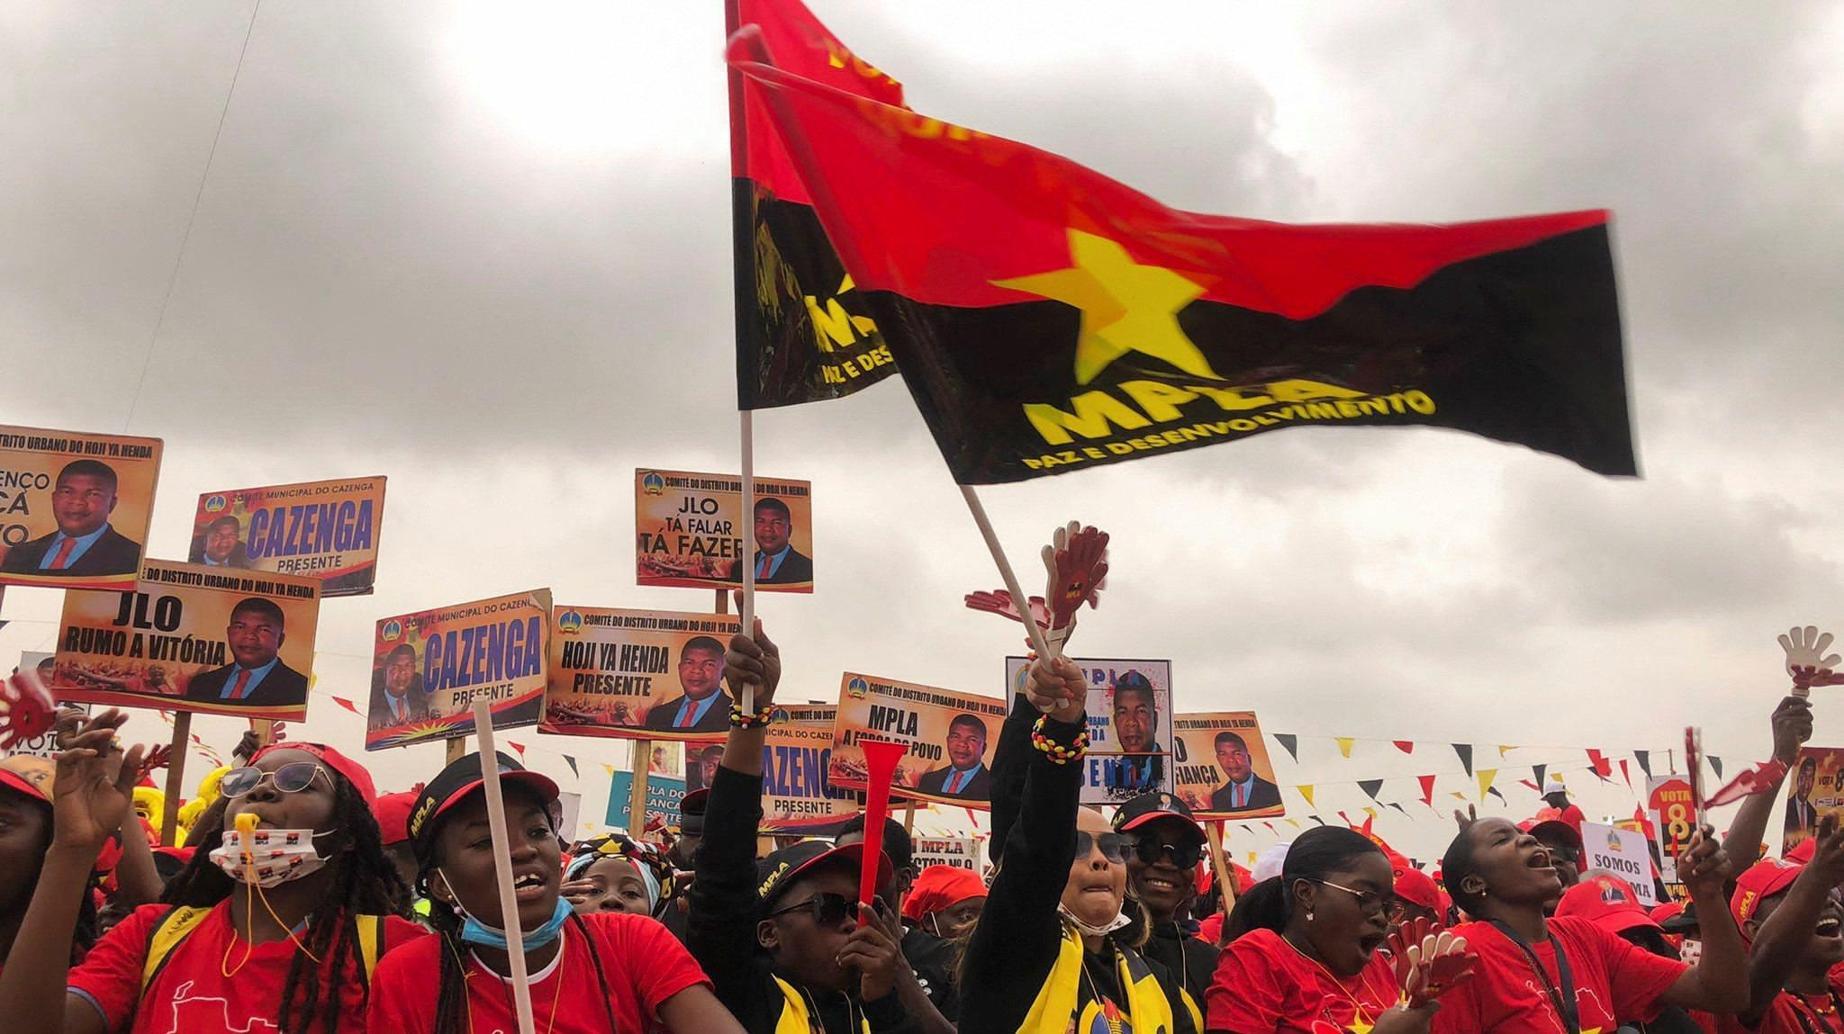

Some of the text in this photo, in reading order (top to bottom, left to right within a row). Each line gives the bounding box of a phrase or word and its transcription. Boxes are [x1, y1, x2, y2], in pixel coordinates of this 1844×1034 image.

[843, 360, 860, 378] E
[1022, 379, 1372, 446] MPLA
[1022, 389, 1437, 470] PAZ E DESENVOLVIMENTO
[27, 436, 69, 452] URBANO
[69, 440, 83, 453] DO
[84, 441, 107, 455] HOJI
[108, 444, 120, 457] YA
[121, 446, 153, 459] HENDA
[266, 488, 313, 499] MUNICIPAL
[315, 486, 330, 495] DO
[332, 483, 374, 493] CAZENGA
[678, 496, 719, 515] JLO
[246, 499, 373, 561] CAZENGA
[665, 514, 733, 536] TÁ FALAR
[640, 527, 744, 559] TÁ FAZER
[277, 555, 342, 572] PRESENTE
[147, 567, 160, 581] DO
[161, 569, 203, 586] DISTRITO
[203, 574, 241, 590] URBANO
[240, 579, 254, 592] DO
[254, 580, 275, 594] HOJI
[275, 583, 286, 596] YA
[286, 584, 314, 599] HENDA
[112, 592, 184, 632] JLO
[438, 608, 482, 622] MUNICIPAL
[483, 604, 498, 615] DO
[583, 613, 612, 627] COMITÉ
[612, 616, 624, 626] DO
[624, 616, 658, 629] DISTRITO
[658, 618, 688, 631] URBANO
[688, 620, 700, 631] DO
[700, 621, 717, 633] HOJI
[717, 622, 727, 633] YA
[65, 625, 227, 666] RUMO A VITÓRIA
[423, 616, 541, 694] CAZENGA
[562, 640, 669, 674] HOJI YA HENDA
[572, 673, 652, 697] PRESENTE
[868, 681, 893, 696] COMITÉ
[893, 687, 903, 698] DO
[902, 688, 931, 703] DISTRITO
[931, 694, 957, 708] URBANO
[956, 699, 966, 709] DO
[790, 709, 813, 720] COMITÉ
[813, 711, 822, 720] DO
[868, 705, 919, 737] MPLA
[795, 730, 808, 739] DO
[842, 729, 851, 746] A
[911, 741, 942, 761] POVO
[668, 789, 687, 800] DO
[774, 799, 832, 814] PRESENTE
[1661, 790, 1690, 801] VOTA
[410, 796, 437, 840] MPLA
[1668, 803, 1690, 840] 8
[921, 840, 964, 854] MPLA
[1594, 853, 1641, 875] SOMOS
[757, 862, 790, 899] MPLA
